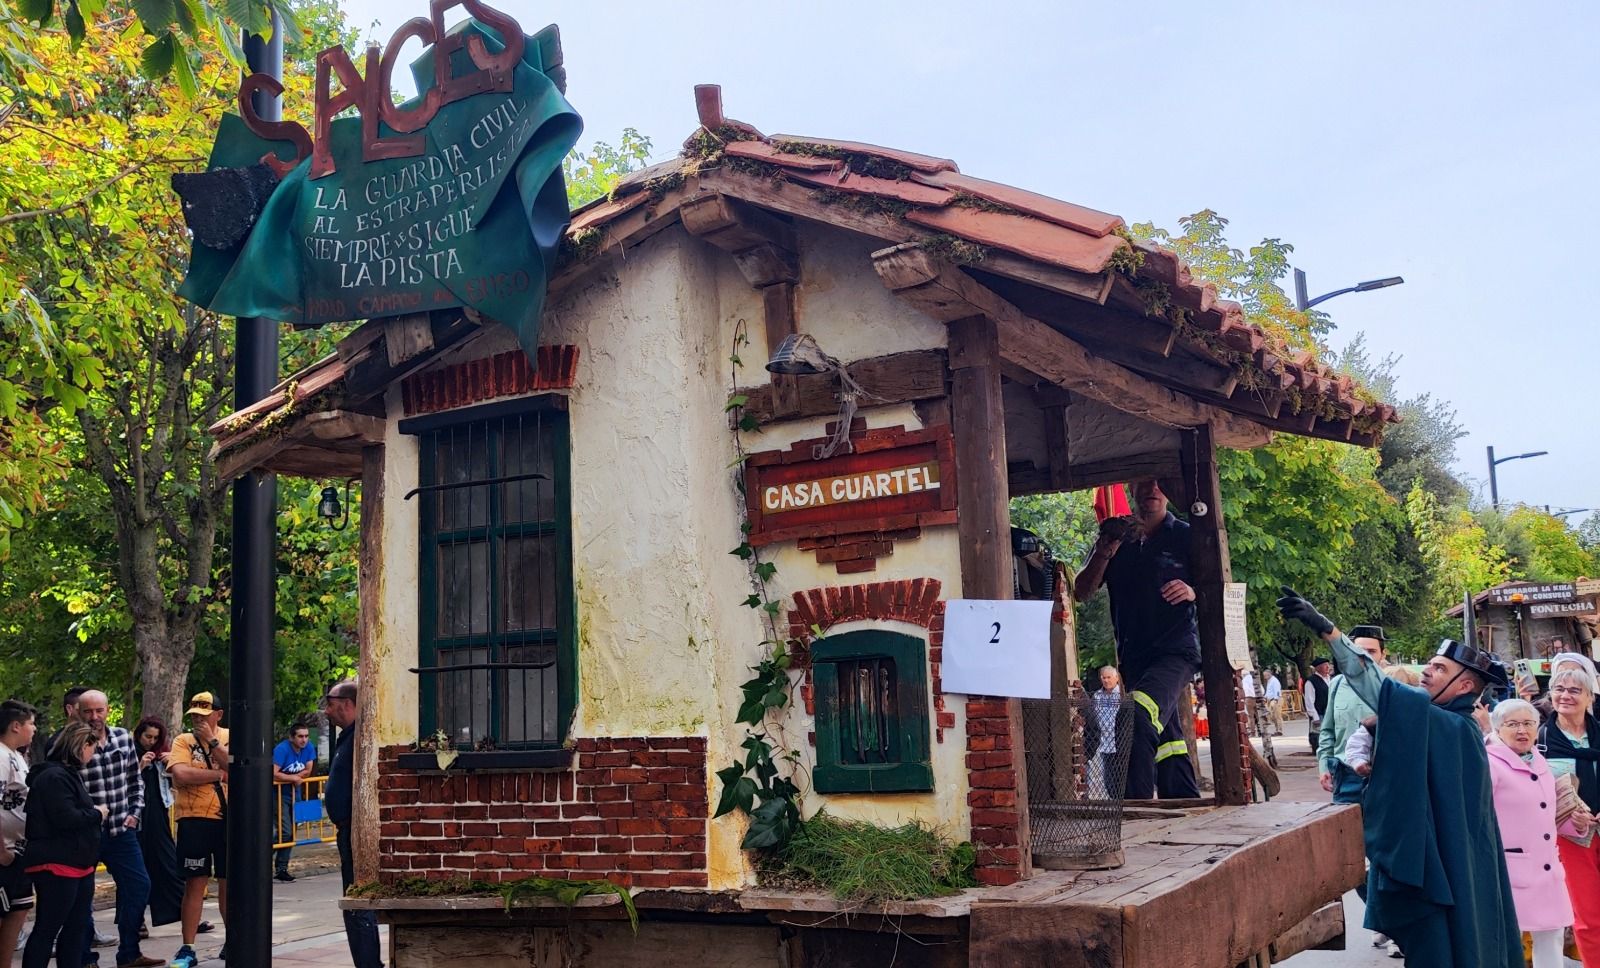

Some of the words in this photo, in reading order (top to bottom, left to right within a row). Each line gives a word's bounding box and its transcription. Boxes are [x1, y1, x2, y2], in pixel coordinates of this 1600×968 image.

[238, 0, 524, 180] SALCES
[313, 216, 340, 234] AL
[356, 118, 530, 232] ESTRAPERLISTA
[314, 187, 348, 211] LA
[365, 144, 469, 205] GUARDIA
[470, 98, 527, 150] CIVIL
[305, 232, 394, 264] SIEMPRE
[408, 205, 477, 250] SIGUE
[340, 263, 375, 288] LA
[380, 248, 465, 286] PISTA
[765, 483, 825, 510] CASA
[831, 466, 941, 501] CUARTEL
[1530, 601, 1595, 614] FONTECHA
[1533, 591, 1572, 600] CONSUELO
[988, 621, 1002, 644] 2
